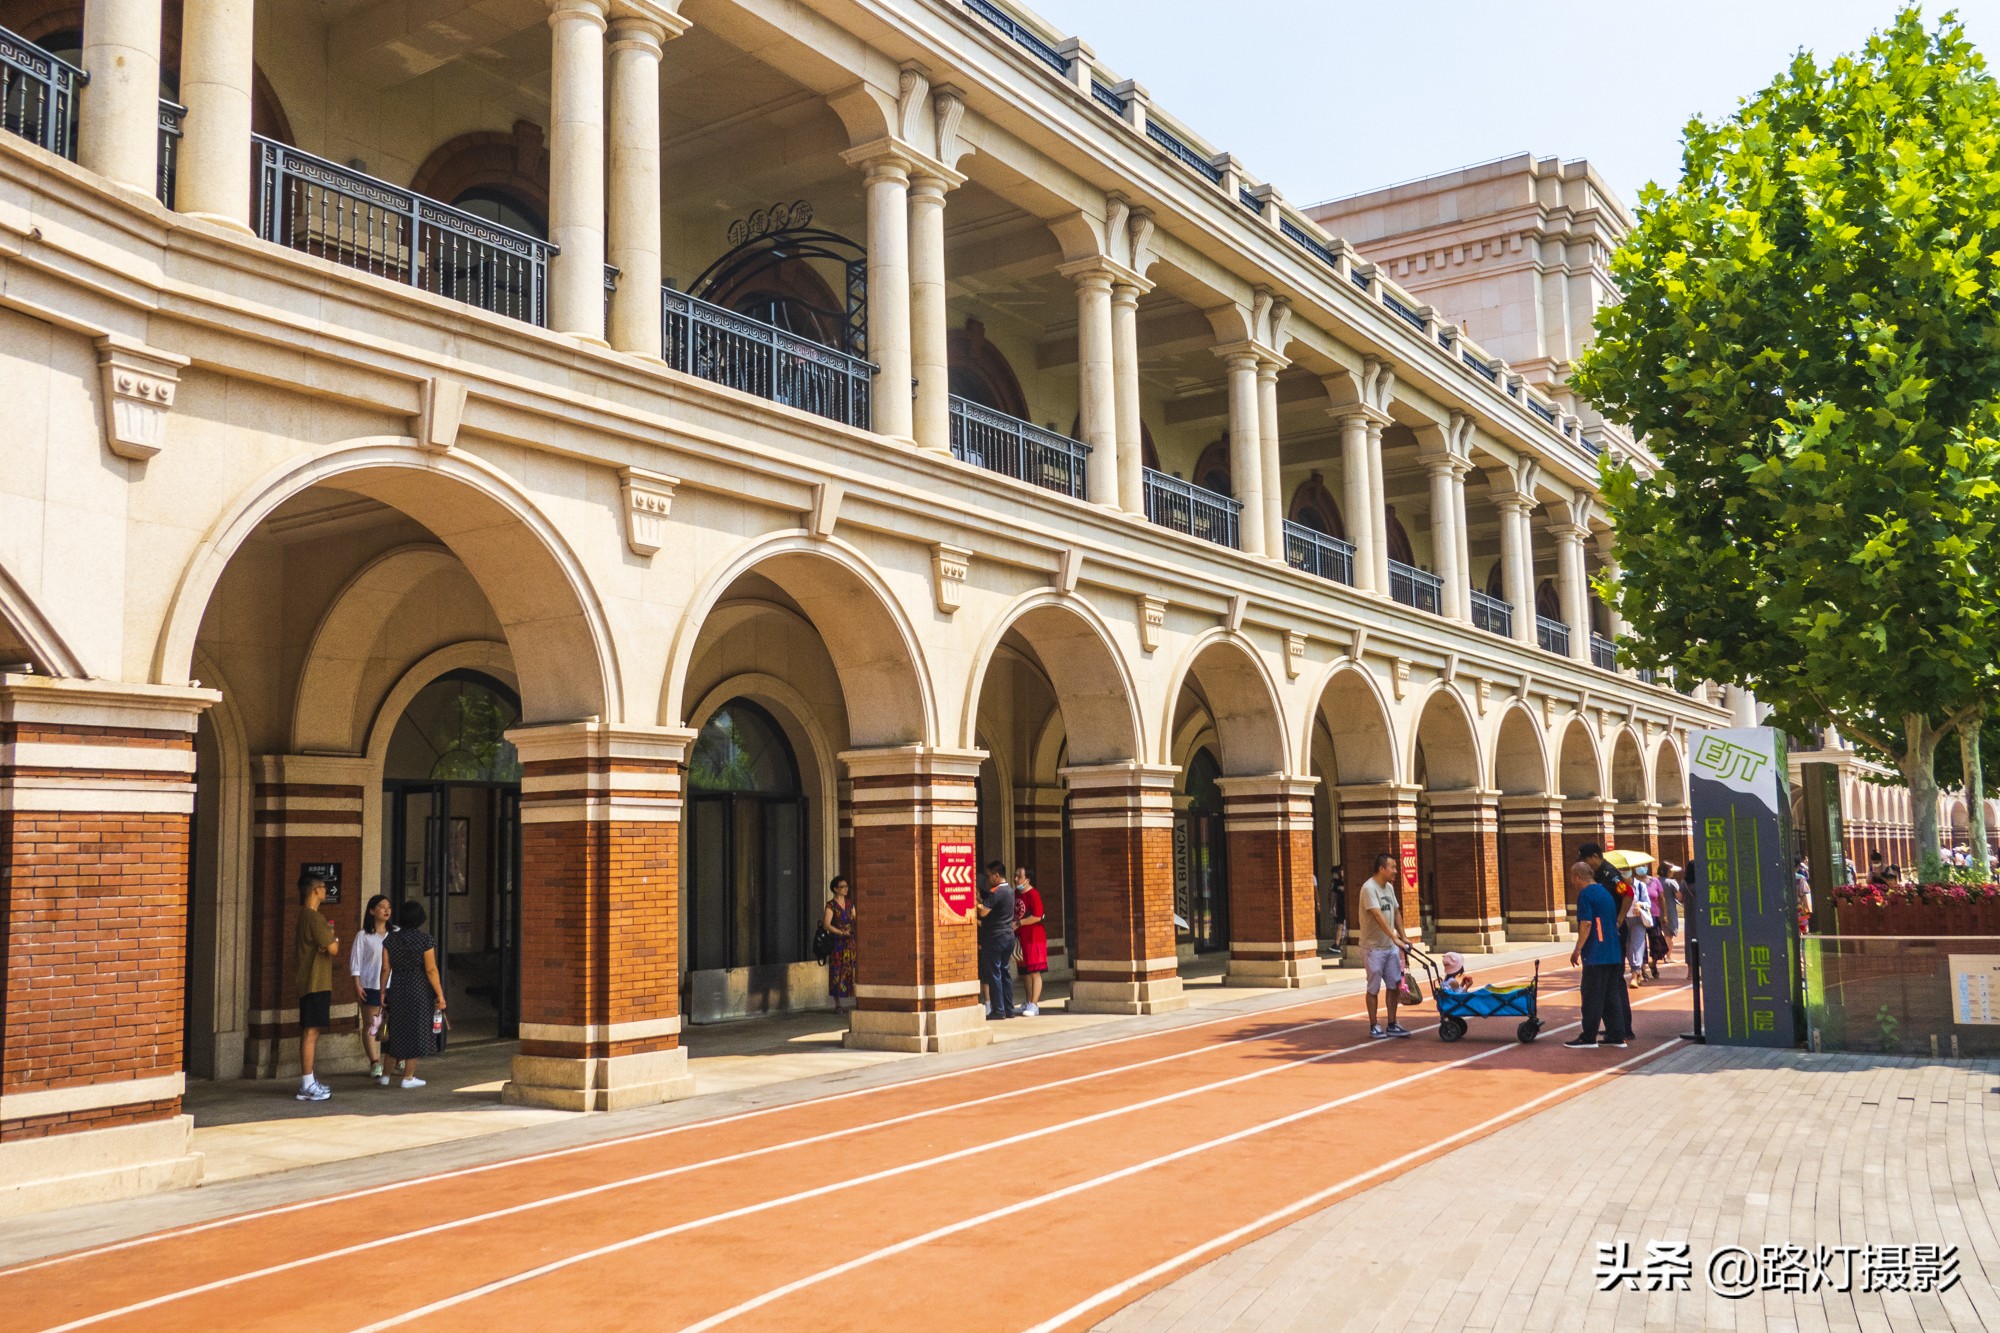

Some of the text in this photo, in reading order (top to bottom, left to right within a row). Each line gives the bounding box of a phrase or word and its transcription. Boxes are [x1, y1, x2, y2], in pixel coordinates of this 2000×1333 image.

[731, 203, 810, 245] 非遗长廊
[1177, 823, 1187, 881] BIANCA
[1705, 817, 1731, 926] 民园保税店
[1750, 946, 1774, 1031] 地下一层
